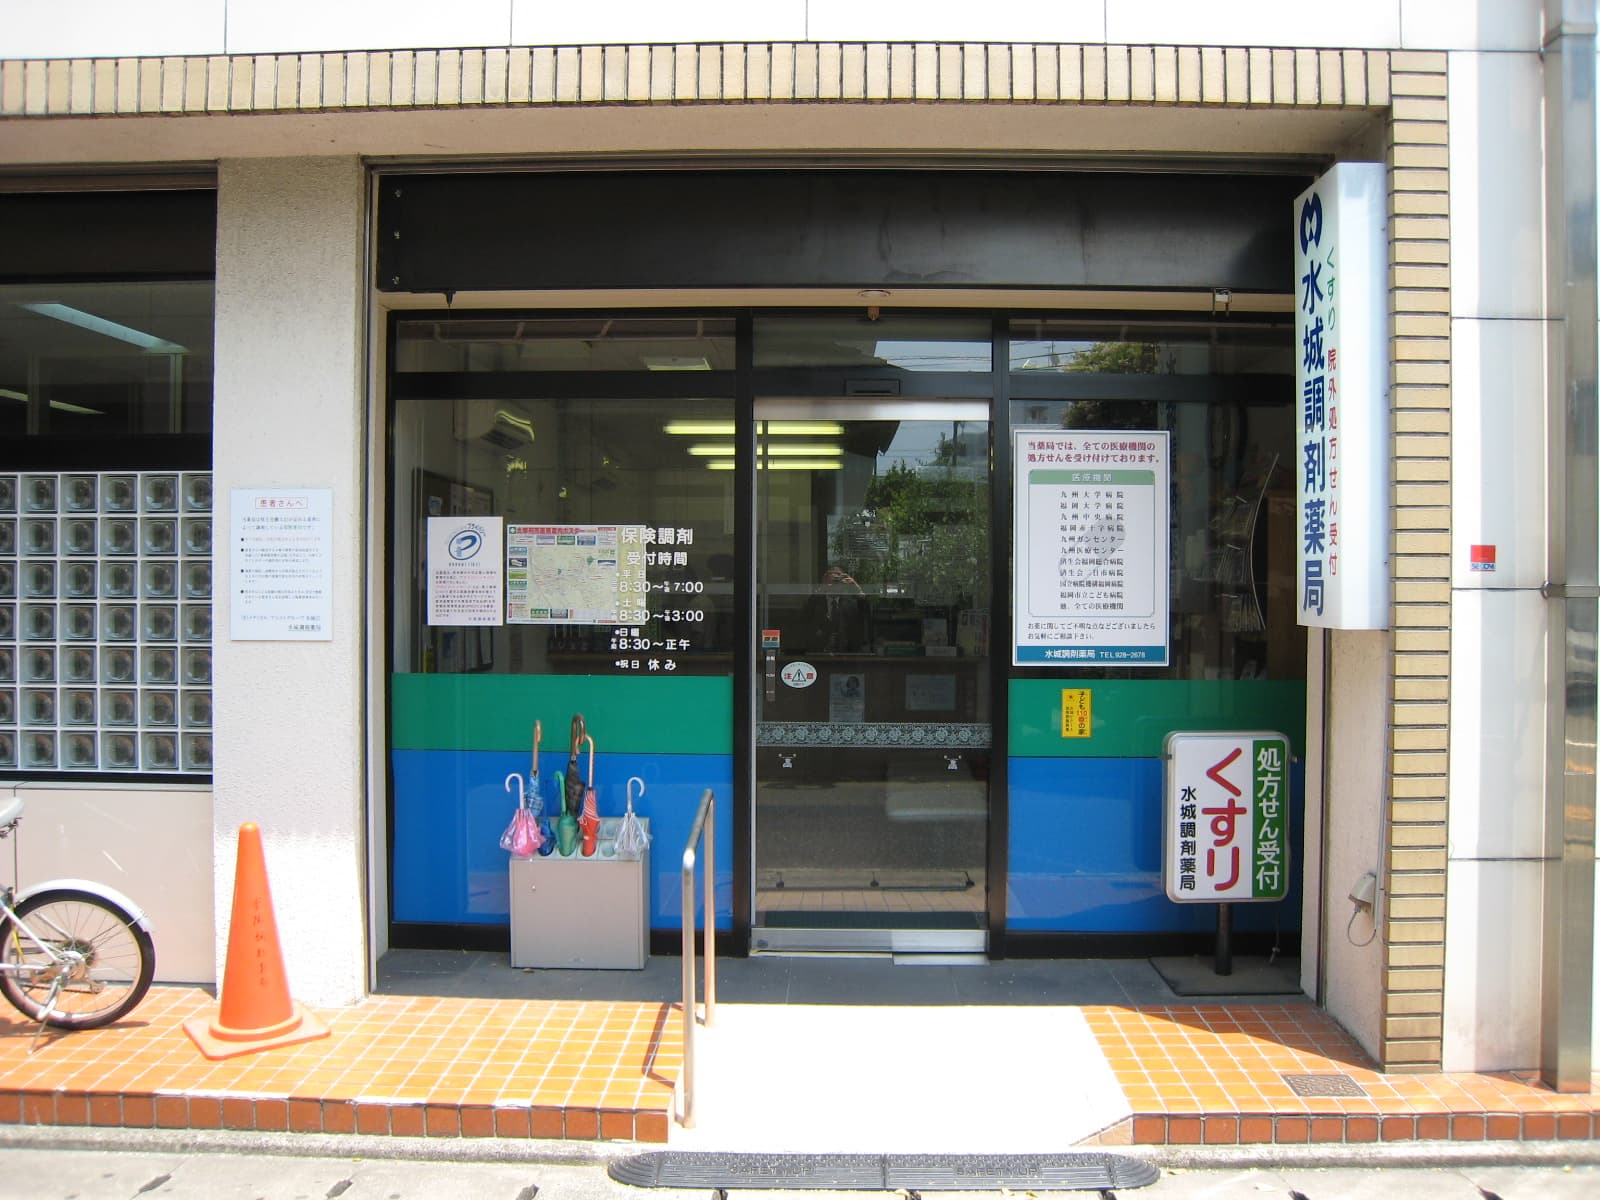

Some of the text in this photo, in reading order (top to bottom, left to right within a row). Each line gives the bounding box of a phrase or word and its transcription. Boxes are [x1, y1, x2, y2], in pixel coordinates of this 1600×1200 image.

[1326, 246, 1339, 576] くすり 院外処方せん受付
[1301, 259, 1326, 617] 水城調剤薬局
[1027, 453, 1160, 463] 処方せんを受け付けております。
[1071, 473, 1112, 483] 医療機関
[621, 527, 694, 545] 保険調剤
[626, 551, 689, 566] 受付時間
[1044, 649, 1096, 659] 水城調剤薬局
[648, 658, 677, 671] 休み
[1201, 747, 1248, 892] くすり
[1256, 747, 1281, 891] 処方せん受付
[1180, 785, 1198, 891] 水城調剤薬局
